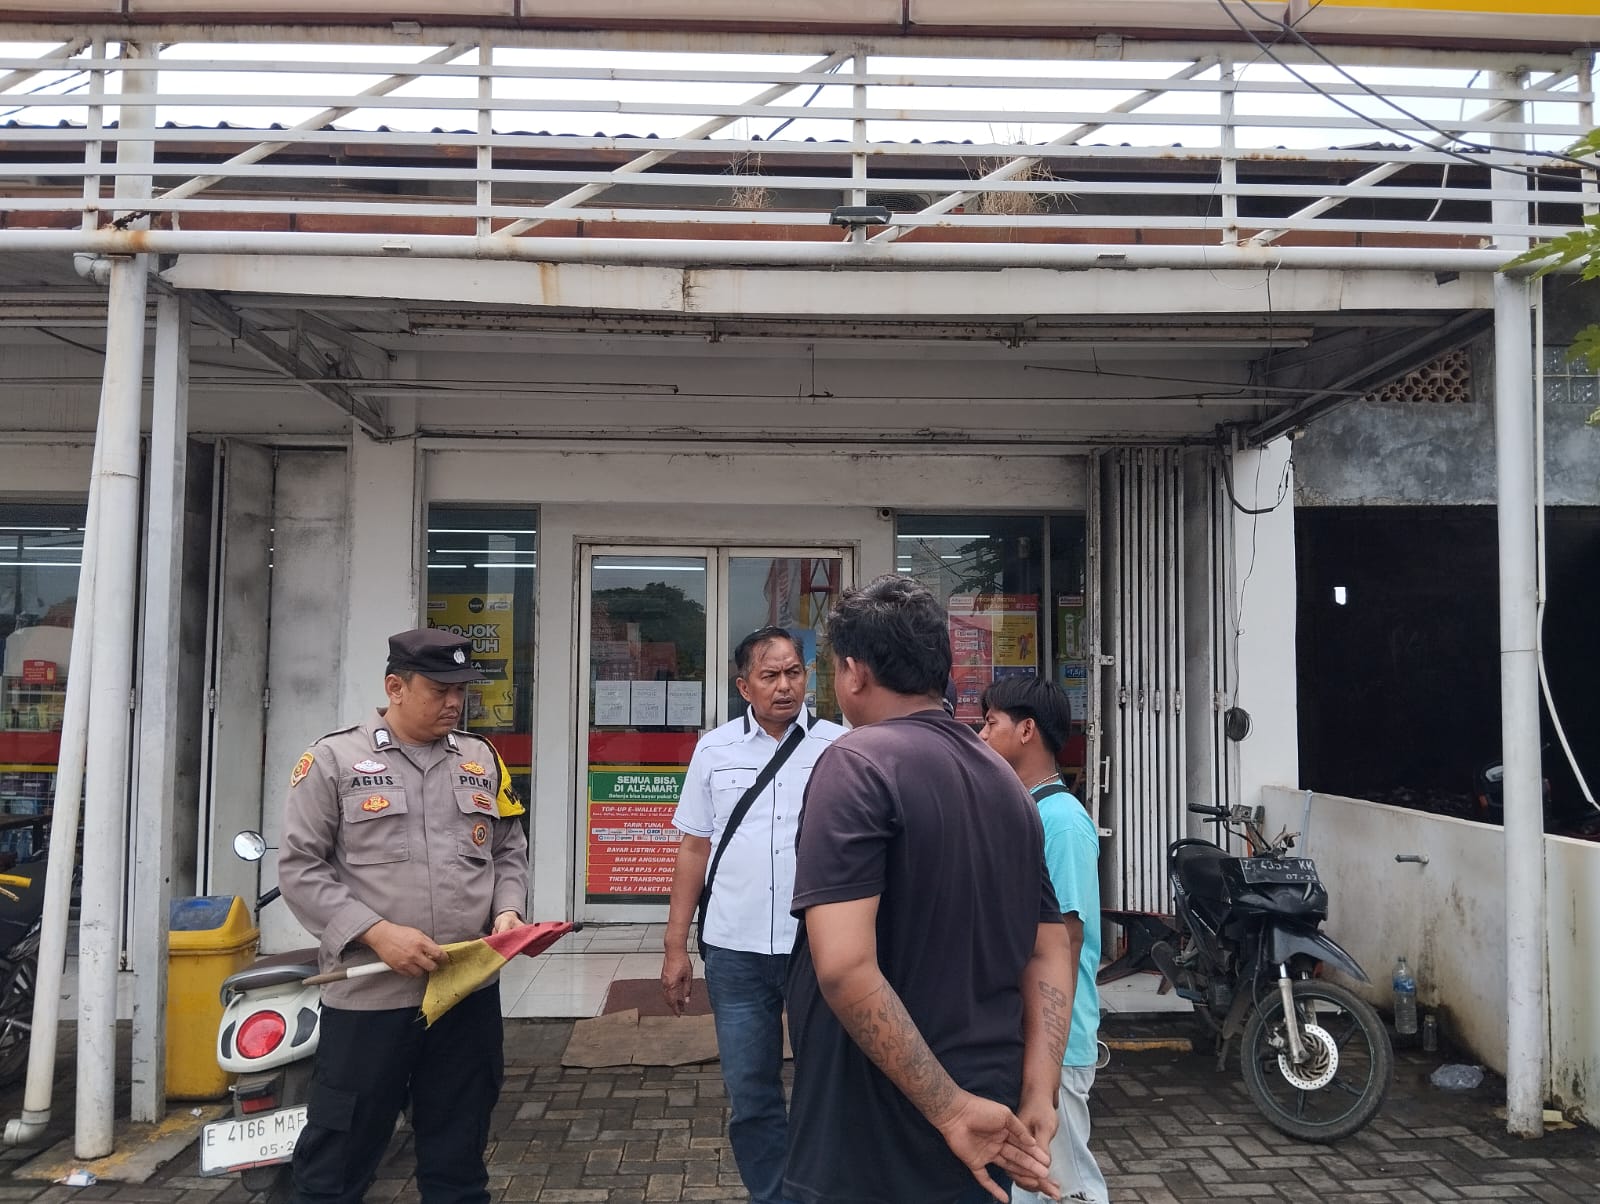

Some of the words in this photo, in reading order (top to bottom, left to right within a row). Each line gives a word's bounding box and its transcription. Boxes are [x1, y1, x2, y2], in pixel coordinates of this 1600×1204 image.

[351, 775, 394, 788] AGUS
[459, 775, 492, 790] POLRI
[617, 776, 650, 785] SEMUA
[653, 776, 677, 785] BISA
[614, 784, 624, 792] DI
[627, 784, 679, 793] ALFAMART
[1242, 860, 1251, 870] Z
[1298, 860, 1314, 871] KK
[207, 1128, 216, 1147] E
[227, 1121, 265, 1143] 4166
